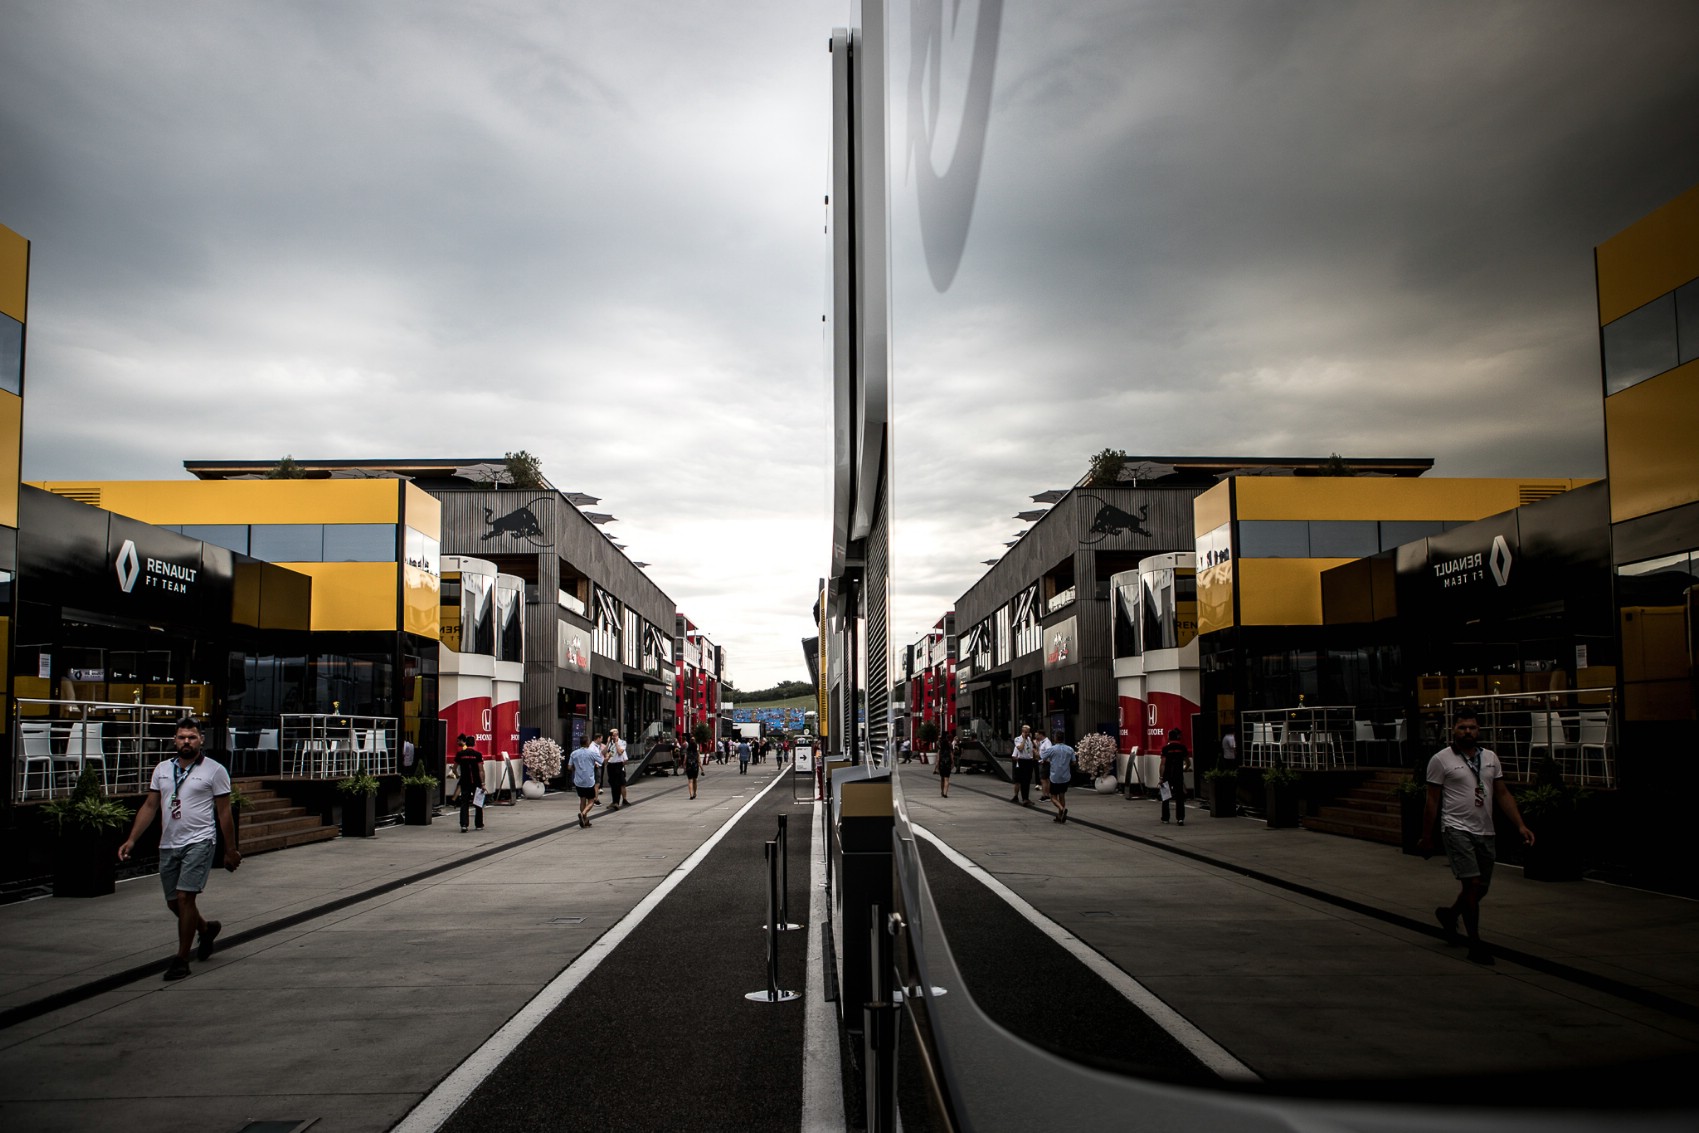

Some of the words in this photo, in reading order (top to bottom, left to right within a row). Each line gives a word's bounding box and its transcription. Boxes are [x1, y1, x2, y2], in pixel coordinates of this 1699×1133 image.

[147, 557, 197, 583] RENAULT
[145, 575, 158, 587] F1
[161, 578, 187, 594] TEAM
